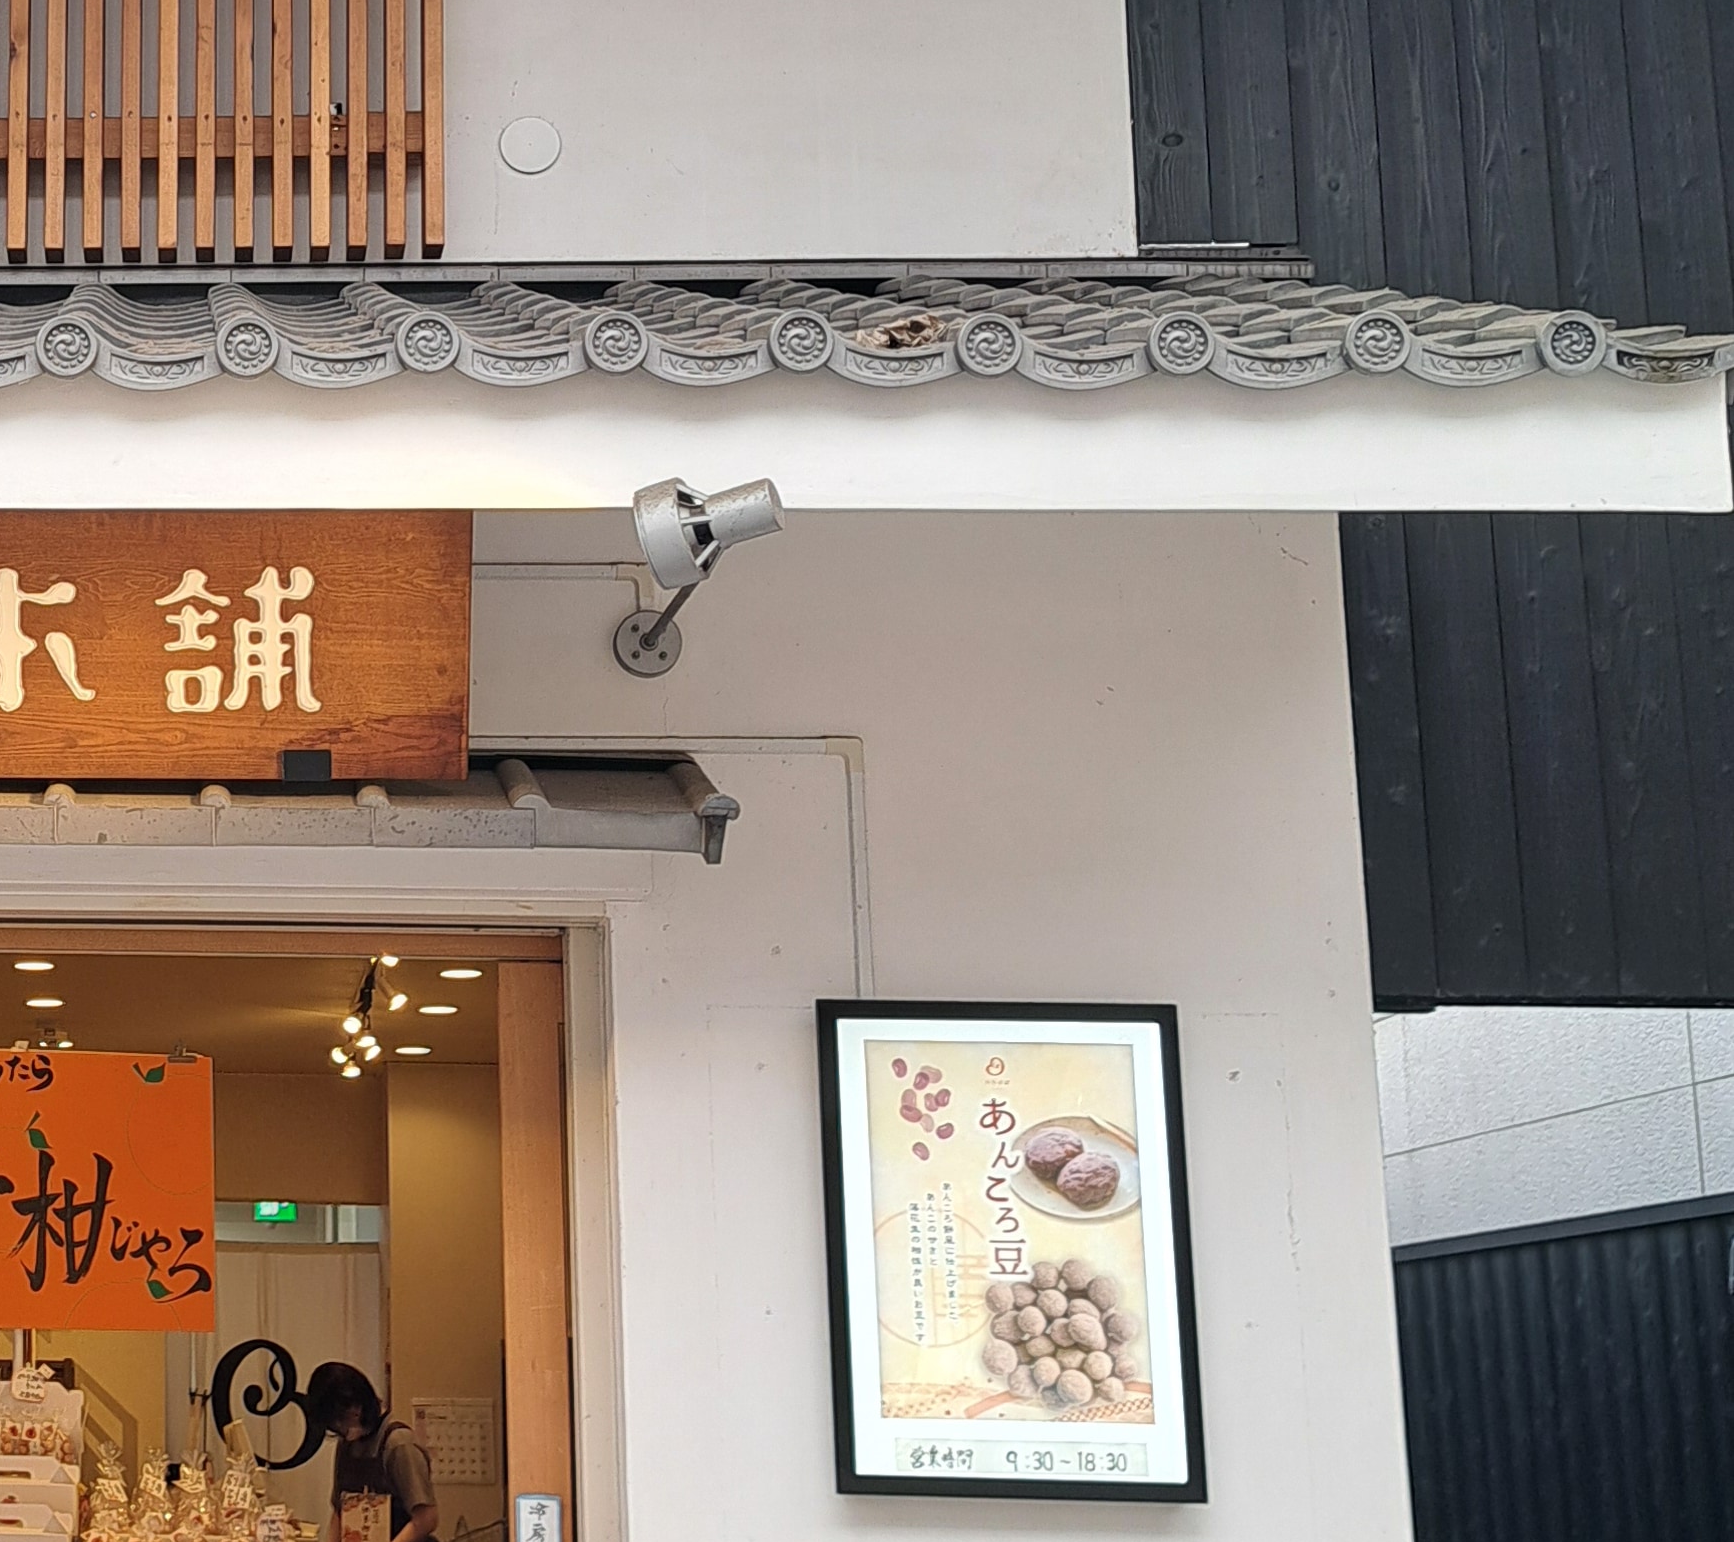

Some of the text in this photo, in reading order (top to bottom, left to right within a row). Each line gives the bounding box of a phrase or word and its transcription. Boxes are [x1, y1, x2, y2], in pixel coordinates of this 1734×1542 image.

[979, 1098, 1029, 1276] あんころ豆
[909, 1446, 974, 1471] 営業時間
